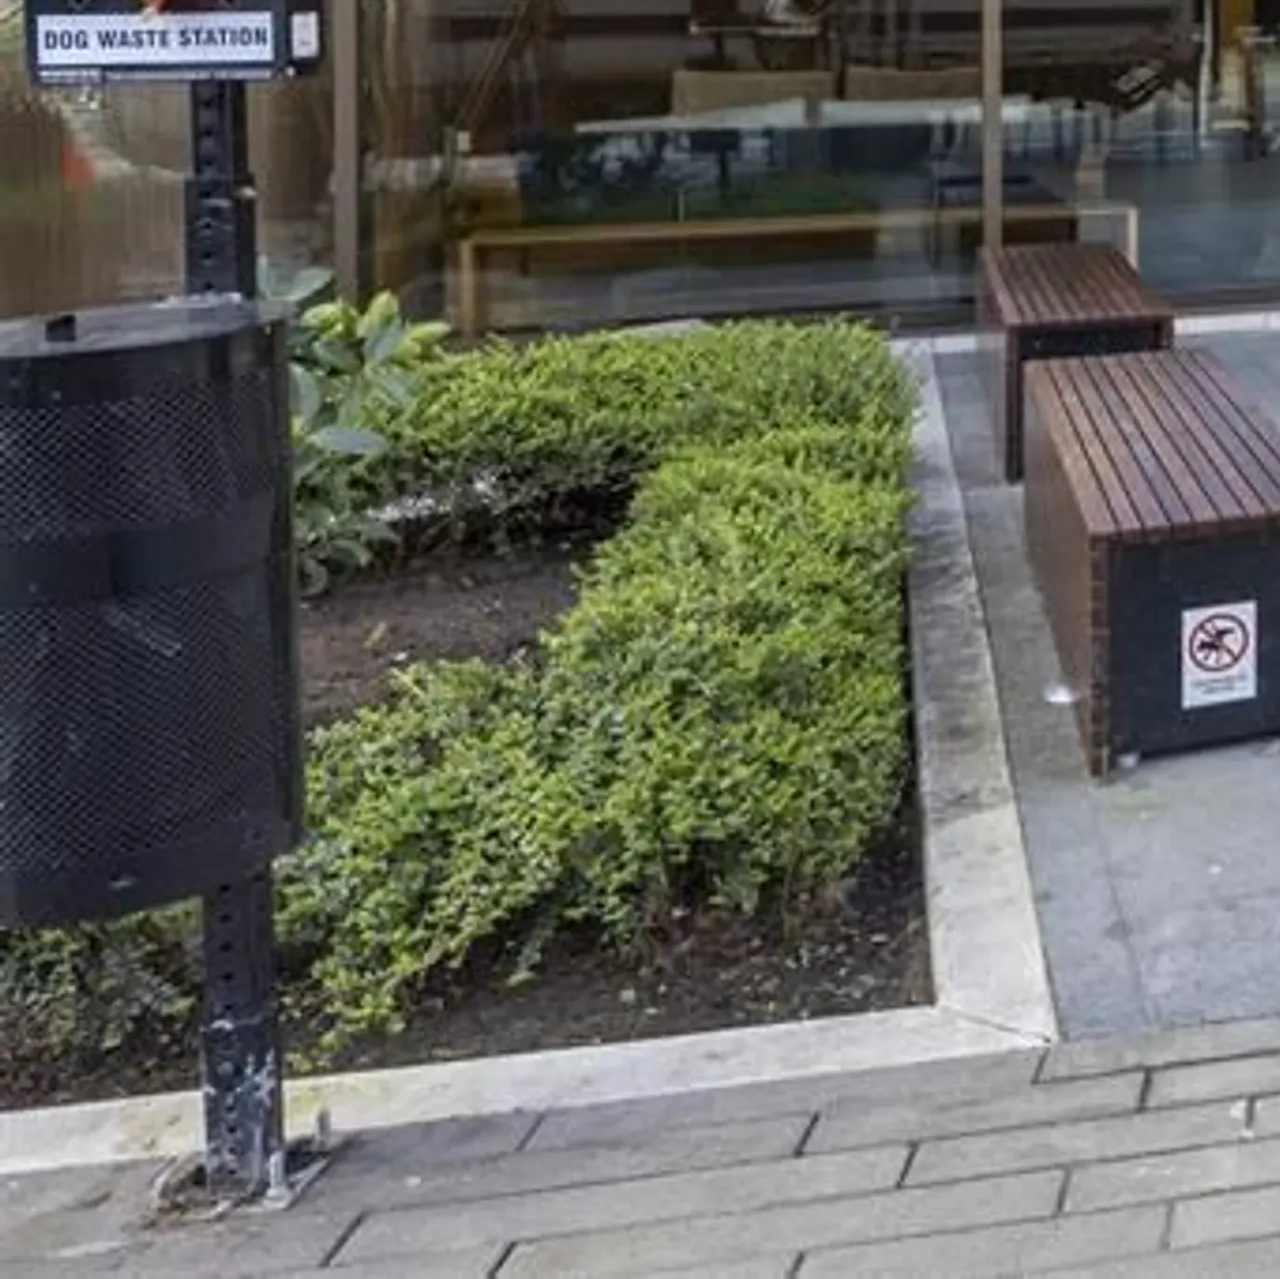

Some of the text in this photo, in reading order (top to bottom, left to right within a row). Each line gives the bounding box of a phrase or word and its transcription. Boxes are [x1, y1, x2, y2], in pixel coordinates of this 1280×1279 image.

[44, 27, 268, 50] DOG WASTE STATION
